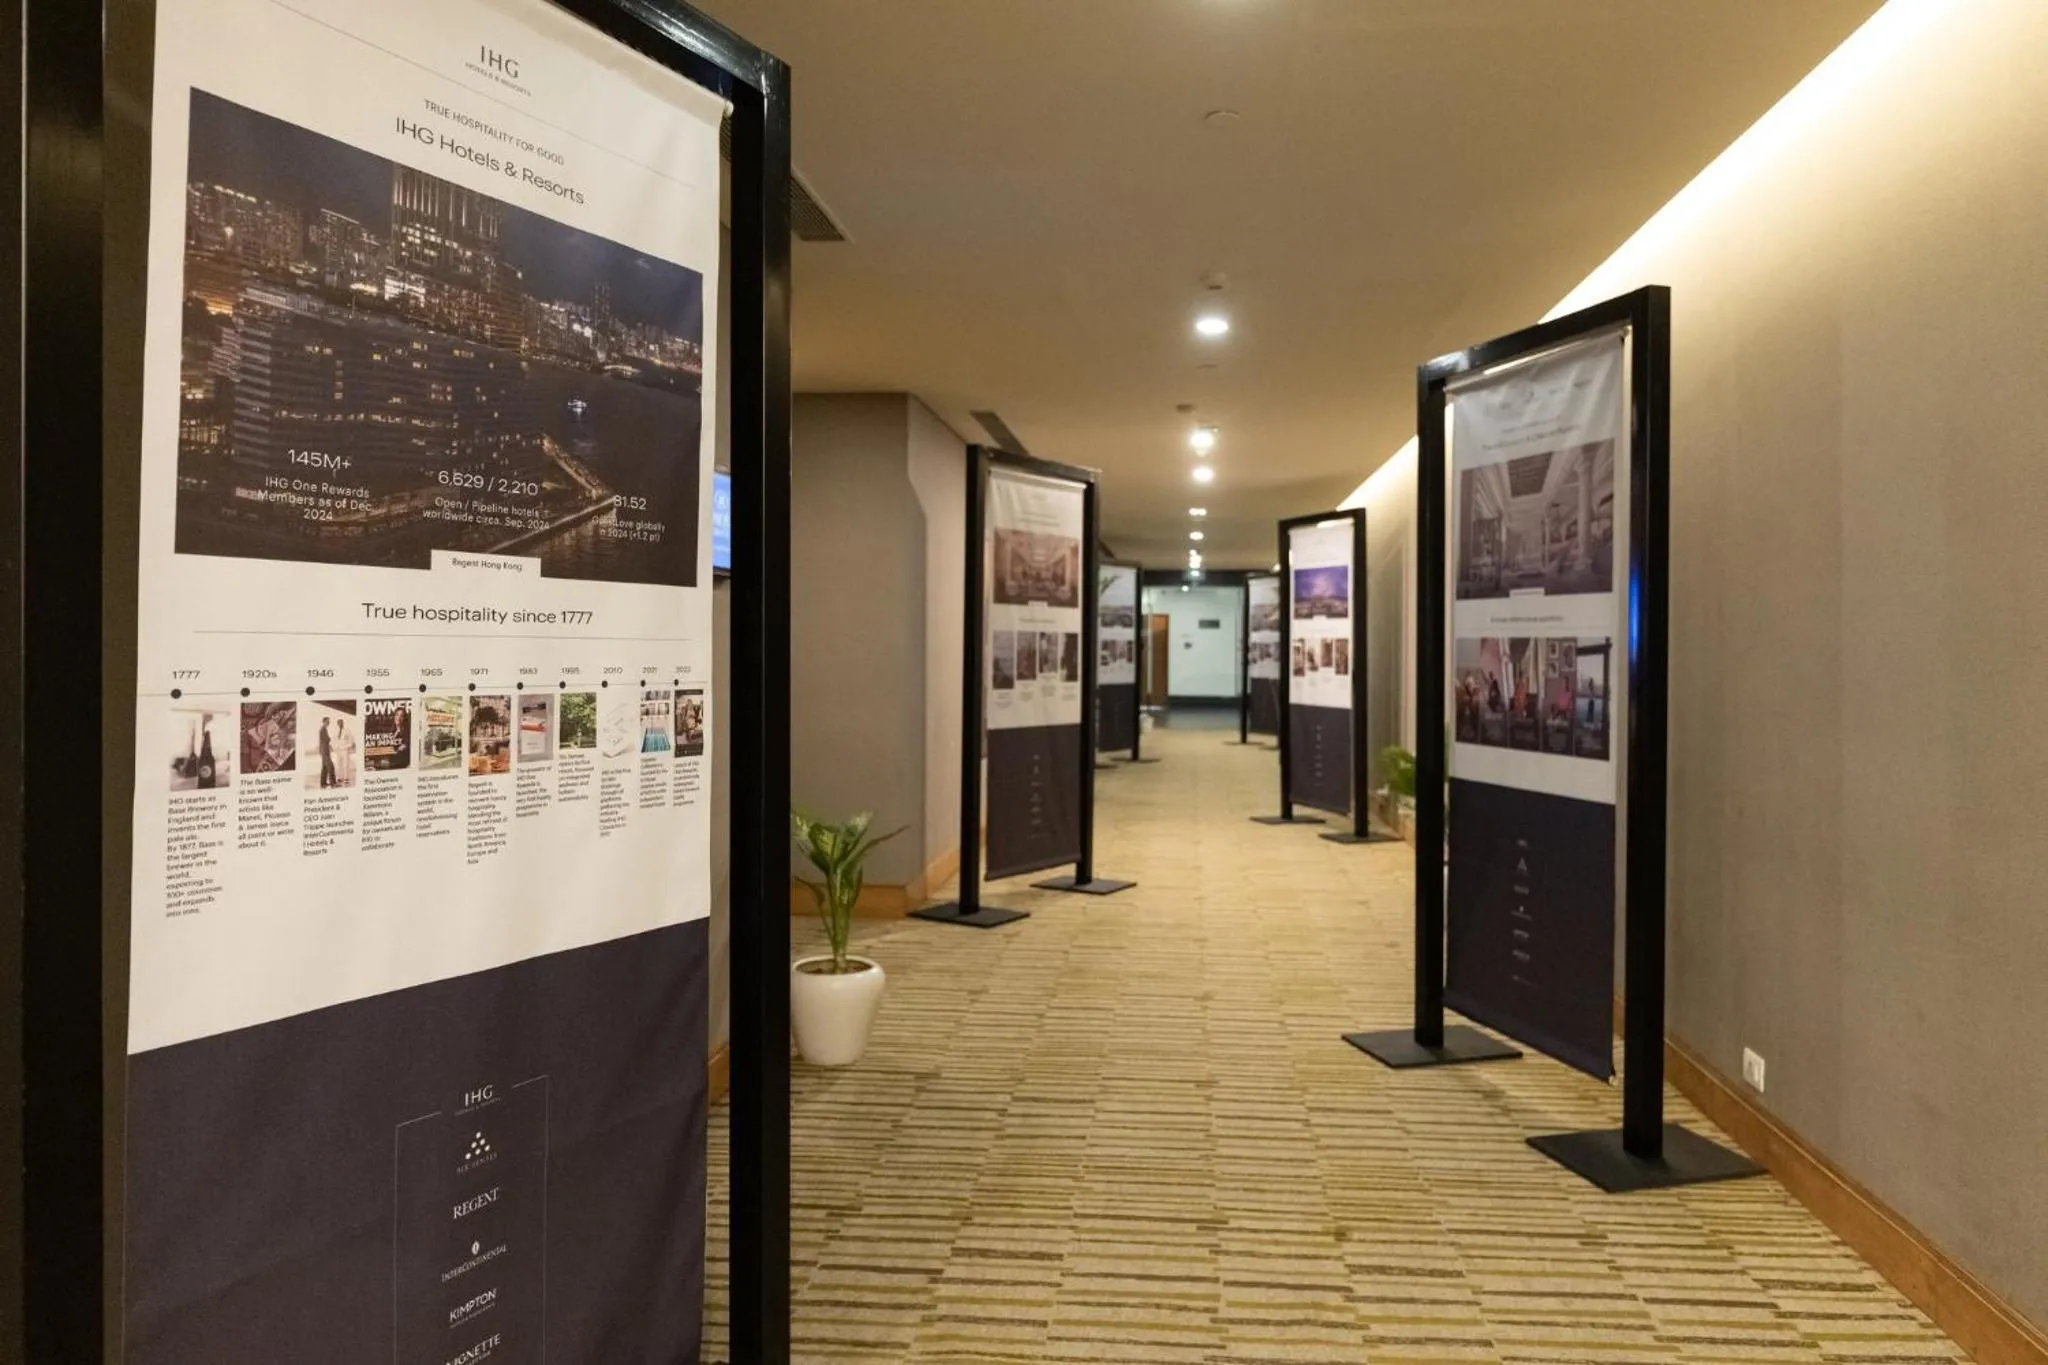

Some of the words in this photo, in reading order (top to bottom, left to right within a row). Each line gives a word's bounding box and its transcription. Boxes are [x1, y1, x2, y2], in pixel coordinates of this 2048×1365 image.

[481, 45, 519, 78] IHG
[424, 99, 450, 119] TRUE
[452, 112, 514, 144] HOSPITALITY
[515, 138, 535, 152] FOR
[537, 147, 564, 166] GOOD
[396, 116, 435, 145] IHG
[439, 134, 500, 172] Hotels
[504, 161, 518, 178] &
[522, 167, 585, 205] Resorts
[288, 449, 352, 470] 145M+
[265, 475, 289, 489] IHG
[292, 479, 318, 492] One
[321, 482, 370, 499] Rewards
[438, 470, 484, 489] 6,629
[487, 476, 495, 492] /
[498, 478, 539, 496] 2,210
[257, 489, 315, 506] Members
[318, 498, 332, 508] as
[335, 498, 347, 509] of
[350, 500, 373, 512] Dec
[434, 496, 462, 511] Open
[471, 500, 509, 514] Pipeline
[511, 505, 539, 518] hotels
[303, 508, 333, 521] 2024
[422, 509, 473, 522] worldwide
[527, 519, 550, 530] 2024
[451, 557, 479, 569] Regent
[480, 559, 502, 570] Hong
[503, 561, 523, 572] Kong
[361, 601, 407, 620] True
[412, 604, 509, 625] hospitality
[512, 608, 557, 624] since
[561, 610, 594, 626] 1777
[172, 669, 201, 680] 1777
[241, 669, 278, 679] 1920s
[306, 668, 334, 679] 1946
[366, 668, 390, 678] 1955
[420, 668, 443, 677] 1965
[603, 666, 623, 674] 2010
[464, 1084, 494, 1107] IHG
[453, 1187, 499, 1219] REGENT
[449, 1288, 497, 1322] KIMPTON
[446, 1332, 501, 1365] IGNETTE
